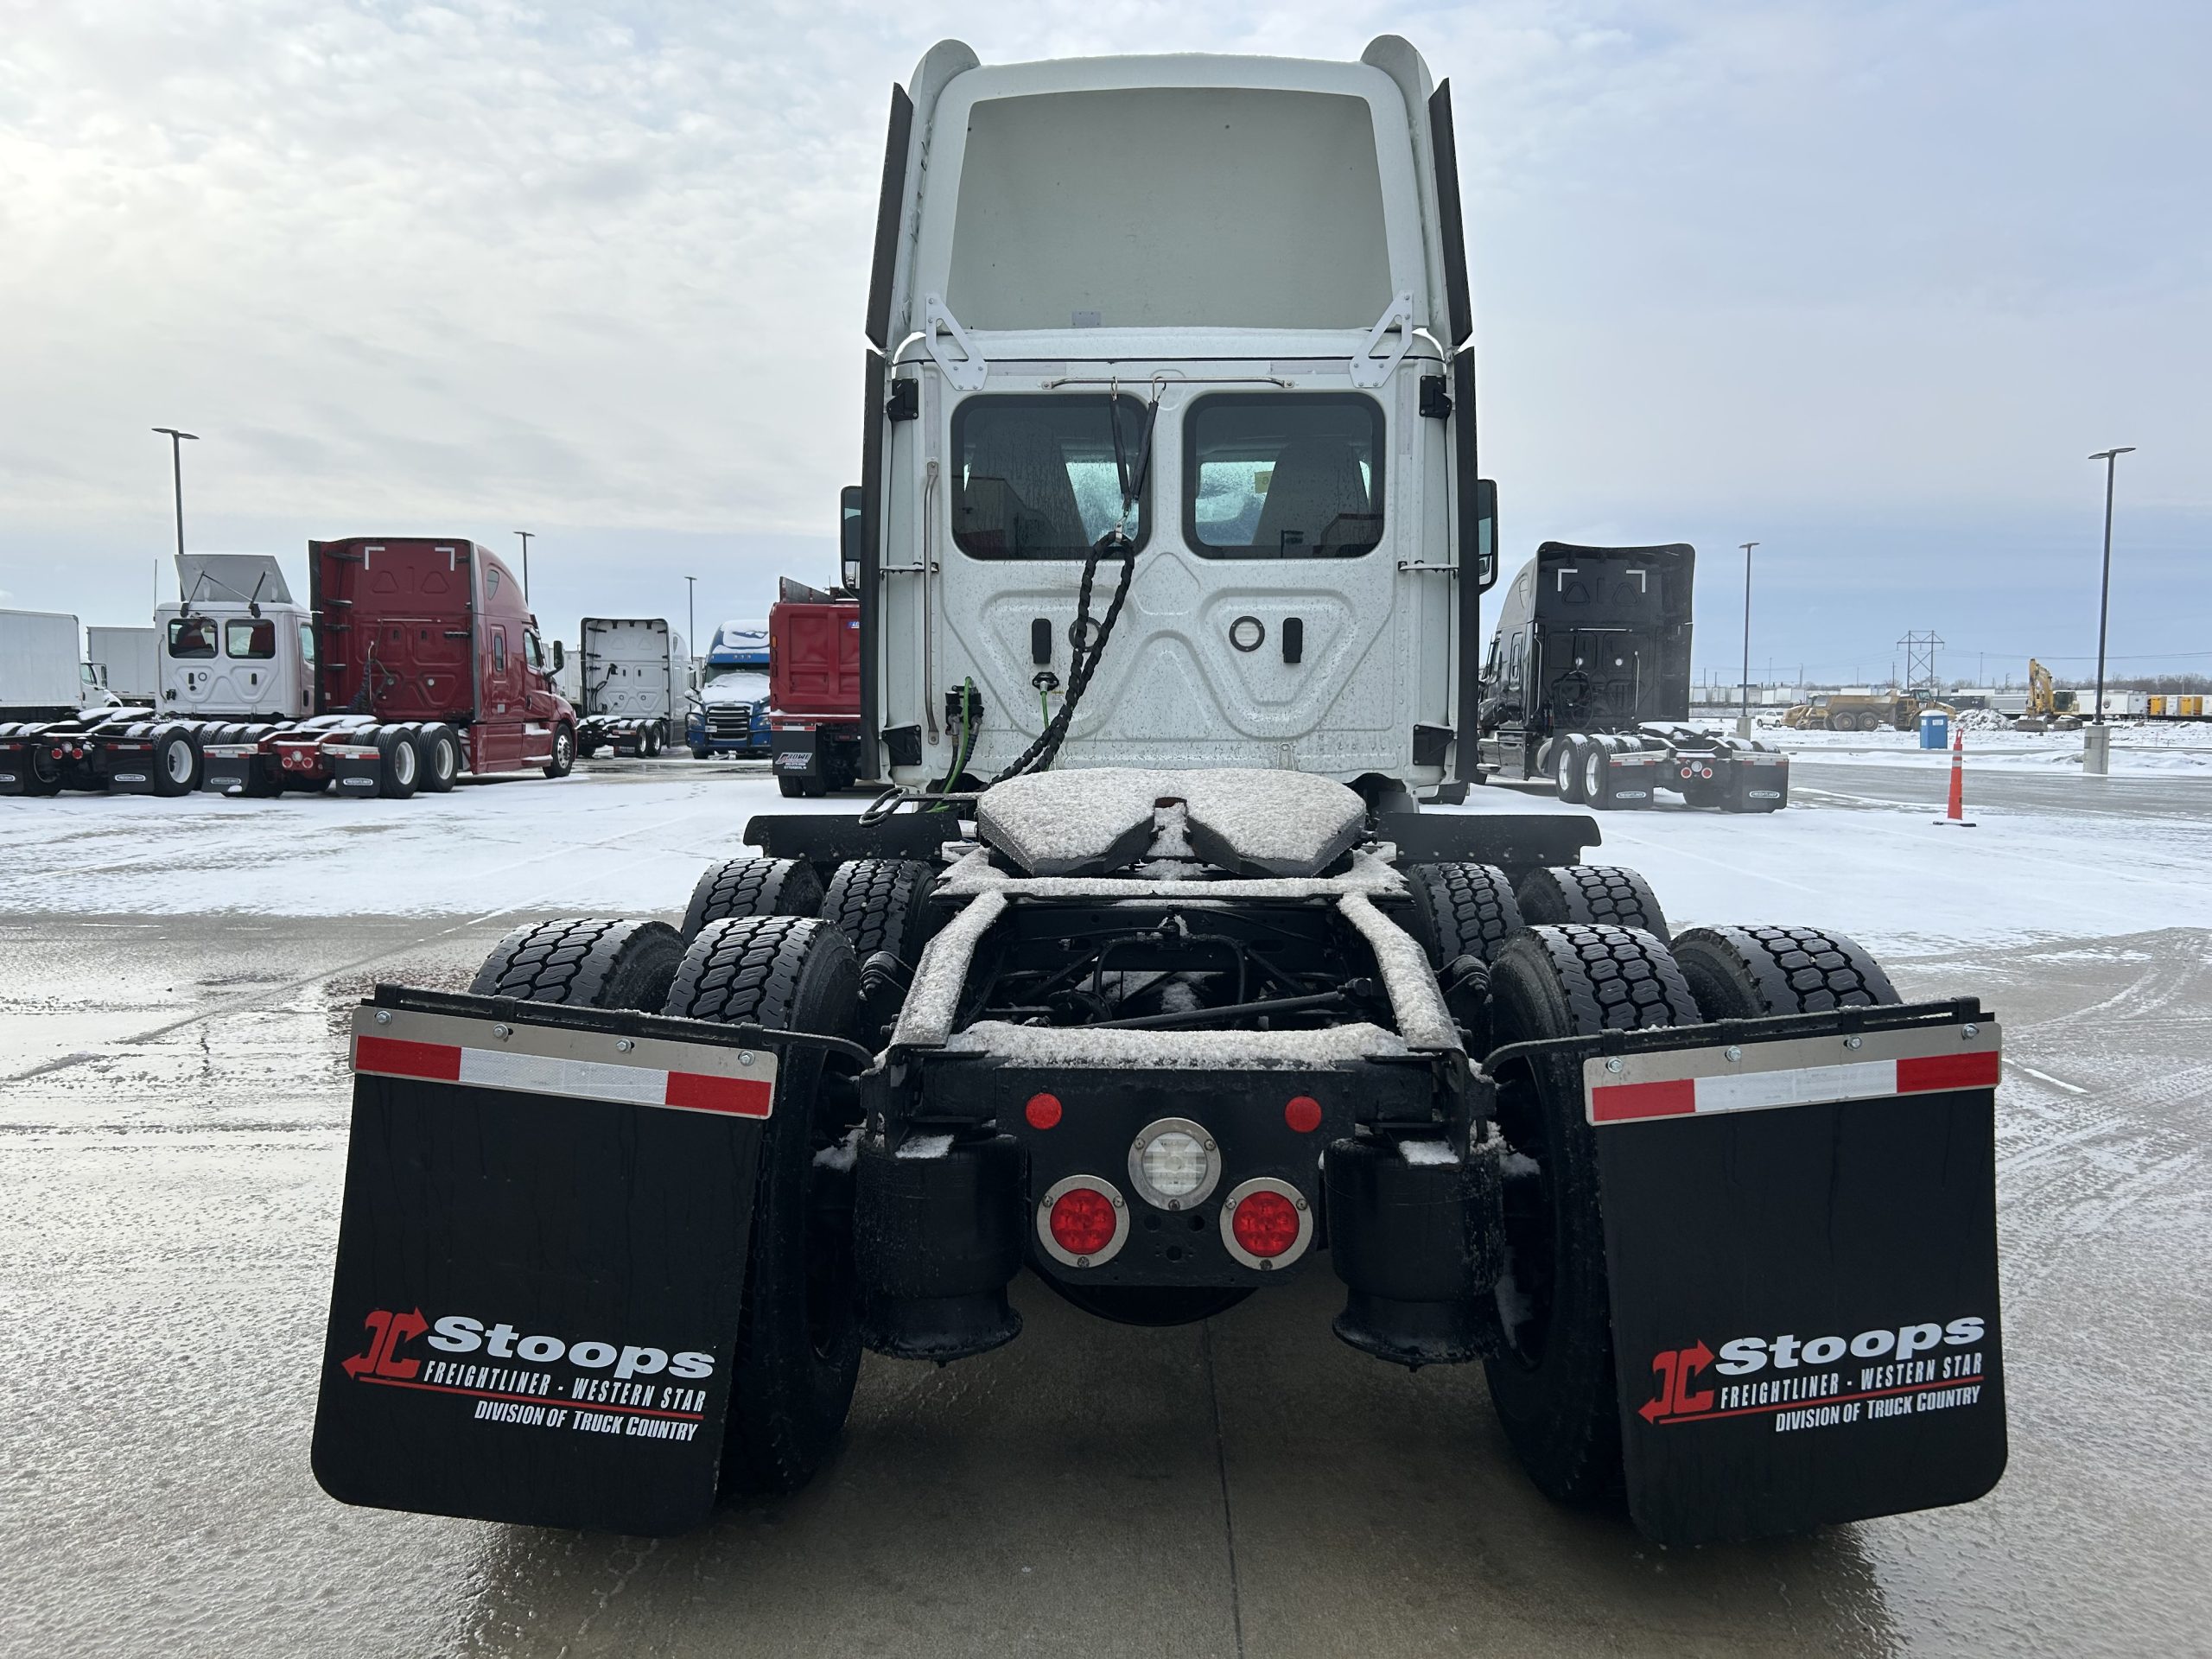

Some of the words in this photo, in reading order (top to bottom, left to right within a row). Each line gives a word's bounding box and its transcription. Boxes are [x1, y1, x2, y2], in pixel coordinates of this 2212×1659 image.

[427, 1316, 715, 1380] Stoops
[1715, 1317, 1985, 1376] Stoops
[423, 1360, 552, 1396] FREIGHTLINER
[572, 1377, 656, 1407] WESTERN
[660, 1387, 707, 1412] STAR
[1720, 1372, 1840, 1409] FREIGHTLINER
[1860, 1359, 1936, 1390] WESTERN
[1942, 1352, 1983, 1380] STAR
[474, 1400, 545, 1426] DIVISION
[546, 1408, 569, 1428] OF
[572, 1410, 625, 1434] TRUCK
[626, 1416, 699, 1441] COUNTRY
[1776, 1405, 1840, 1432] DIVISION
[1843, 1403, 1860, 1423] OF
[1866, 1395, 1913, 1420] TRUCK
[1916, 1385, 1981, 1413] COUNTRY
